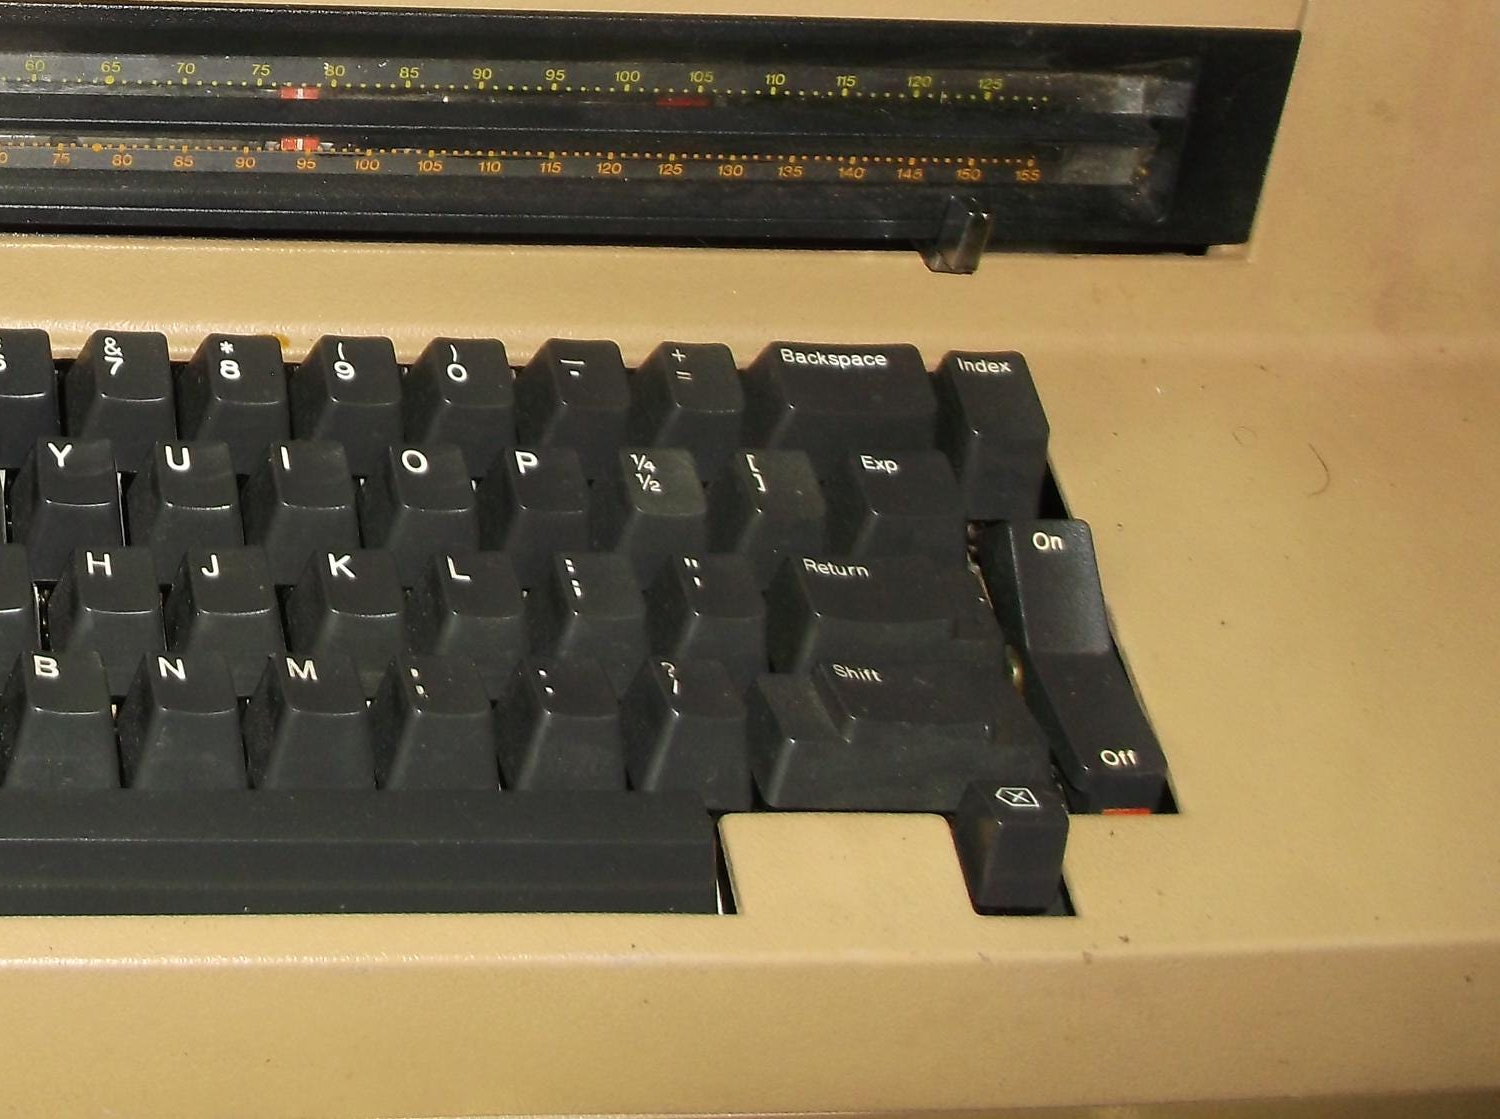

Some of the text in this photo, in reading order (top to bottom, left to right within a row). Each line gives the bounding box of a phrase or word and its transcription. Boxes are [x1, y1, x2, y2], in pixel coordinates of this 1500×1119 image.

[25, 60, 45, 72] 60
[101, 61, 121, 73] 65
[178, 63, 196, 74] 70
[253, 64, 271, 76] 75
[398, 67, 420, 79] 85
[474, 68, 492, 79] 90
[546, 69, 565, 81] 95
[616, 70, 642, 82] 100
[691, 71, 714, 83] 105
[767, 73, 787, 85] 110
[837, 75, 858, 87] 115
[909, 76, 932, 87] 120
[980, 78, 1003, 89] 125
[53, 152, 70, 165] 75
[112, 154, 132, 166] 80
[174, 155, 194, 168] 85
[236, 157, 256, 169] 90
[297, 158, 316, 170] 95
[356, 159, 380, 171] 100
[420, 160, 443, 172] 105
[480, 161, 502, 173] 110
[541, 162, 562, 174] 115
[598, 163, 622, 174] 120
[660, 163, 683, 176] 125
[719, 165, 744, 177] 130
[779, 166, 804, 177] 135
[104, 337, 122, 356] &
[672, 349, 686, 362] +
[105, 356, 123, 375] 7
[220, 360, 240, 379] 8
[781, 349, 887, 369] Backspace
[958, 358, 1011, 373] Index
[335, 361, 355, 380] 9
[676, 371, 692, 380] =
[48, 443, 72, 467] Y
[166, 446, 190, 471] U
[402, 450, 428, 473] O
[516, 451, 538, 474] P
[861, 456, 898, 474] Exp
[1033, 532, 1064, 551] On
[87, 552, 111, 576] H
[202, 555, 219, 577] J
[329, 554, 355, 578] K
[447, 557, 470, 581] L
[803, 559, 869, 577] Return
[34, 656, 59, 678] B
[158, 657, 185, 680] N
[287, 658, 317, 680] M
[833, 665, 881, 682] Shift
[1101, 750, 1136, 766] Off
